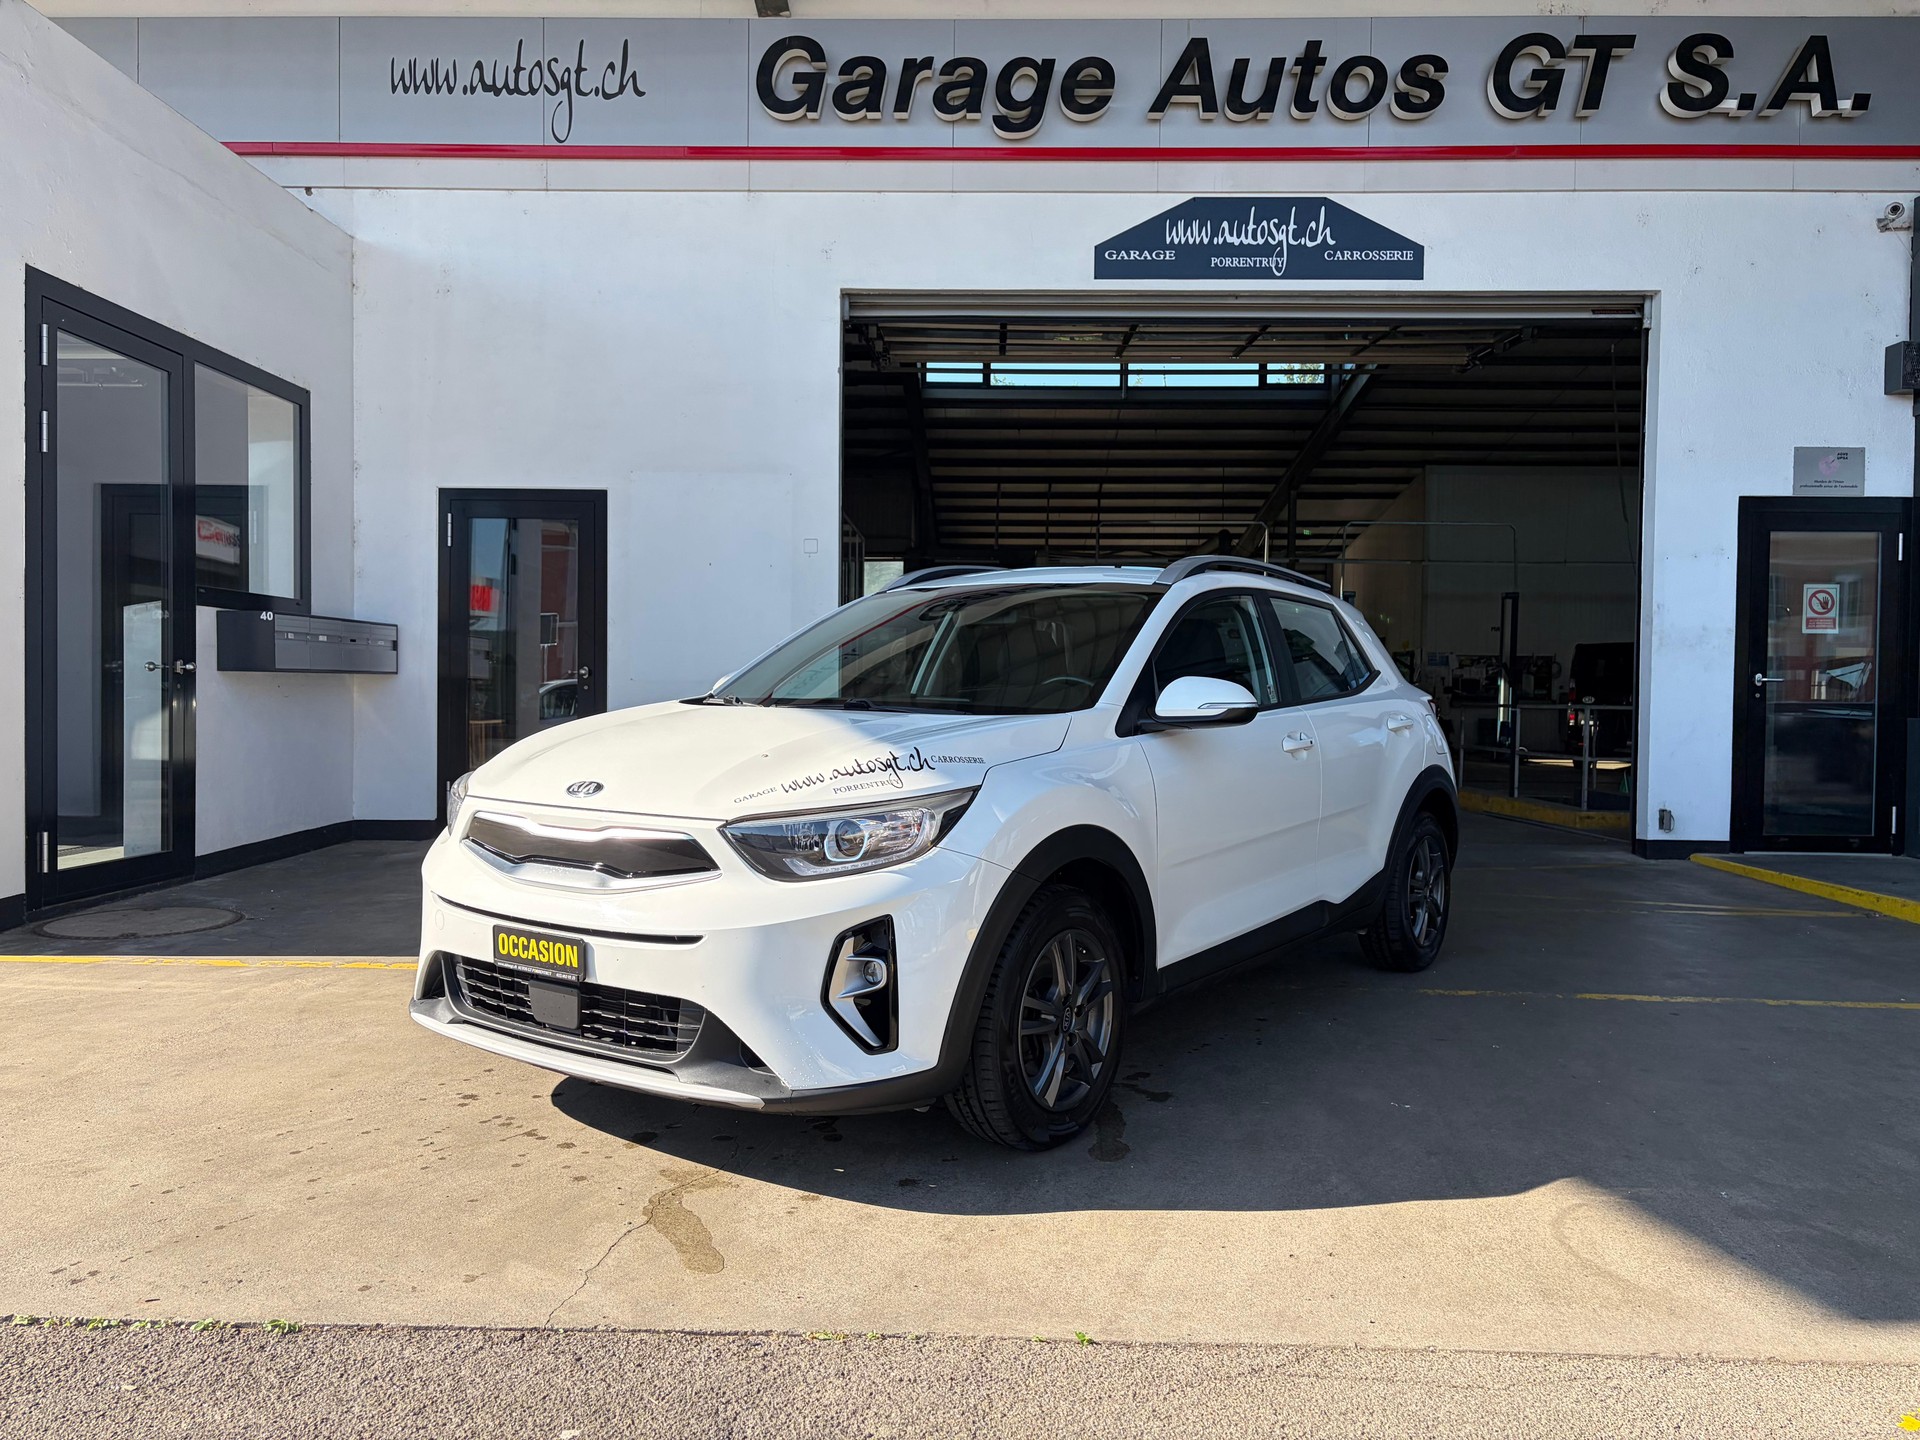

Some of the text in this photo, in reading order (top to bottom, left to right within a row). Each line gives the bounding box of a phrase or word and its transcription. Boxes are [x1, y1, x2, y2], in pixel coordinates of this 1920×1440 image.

[391, 39, 646, 143] www.autosgt.ch
[756, 32, 1872, 139] Garage Autos GT S.A.
[1165, 206, 1336, 276] www.autosgt.ch
[1104, 250, 1176, 261] GARAGE
[1210, 256, 1285, 268] PORRENTRUY
[1323, 250, 1414, 262] CARROSSERIE
[260, 611, 274, 621] 40
[733, 746, 987, 804] GARAGE www.autosgt.ch CARROSSERIE
[832, 778, 902, 795] PORRENTRUY
[498, 932, 579, 968] OCCASION
